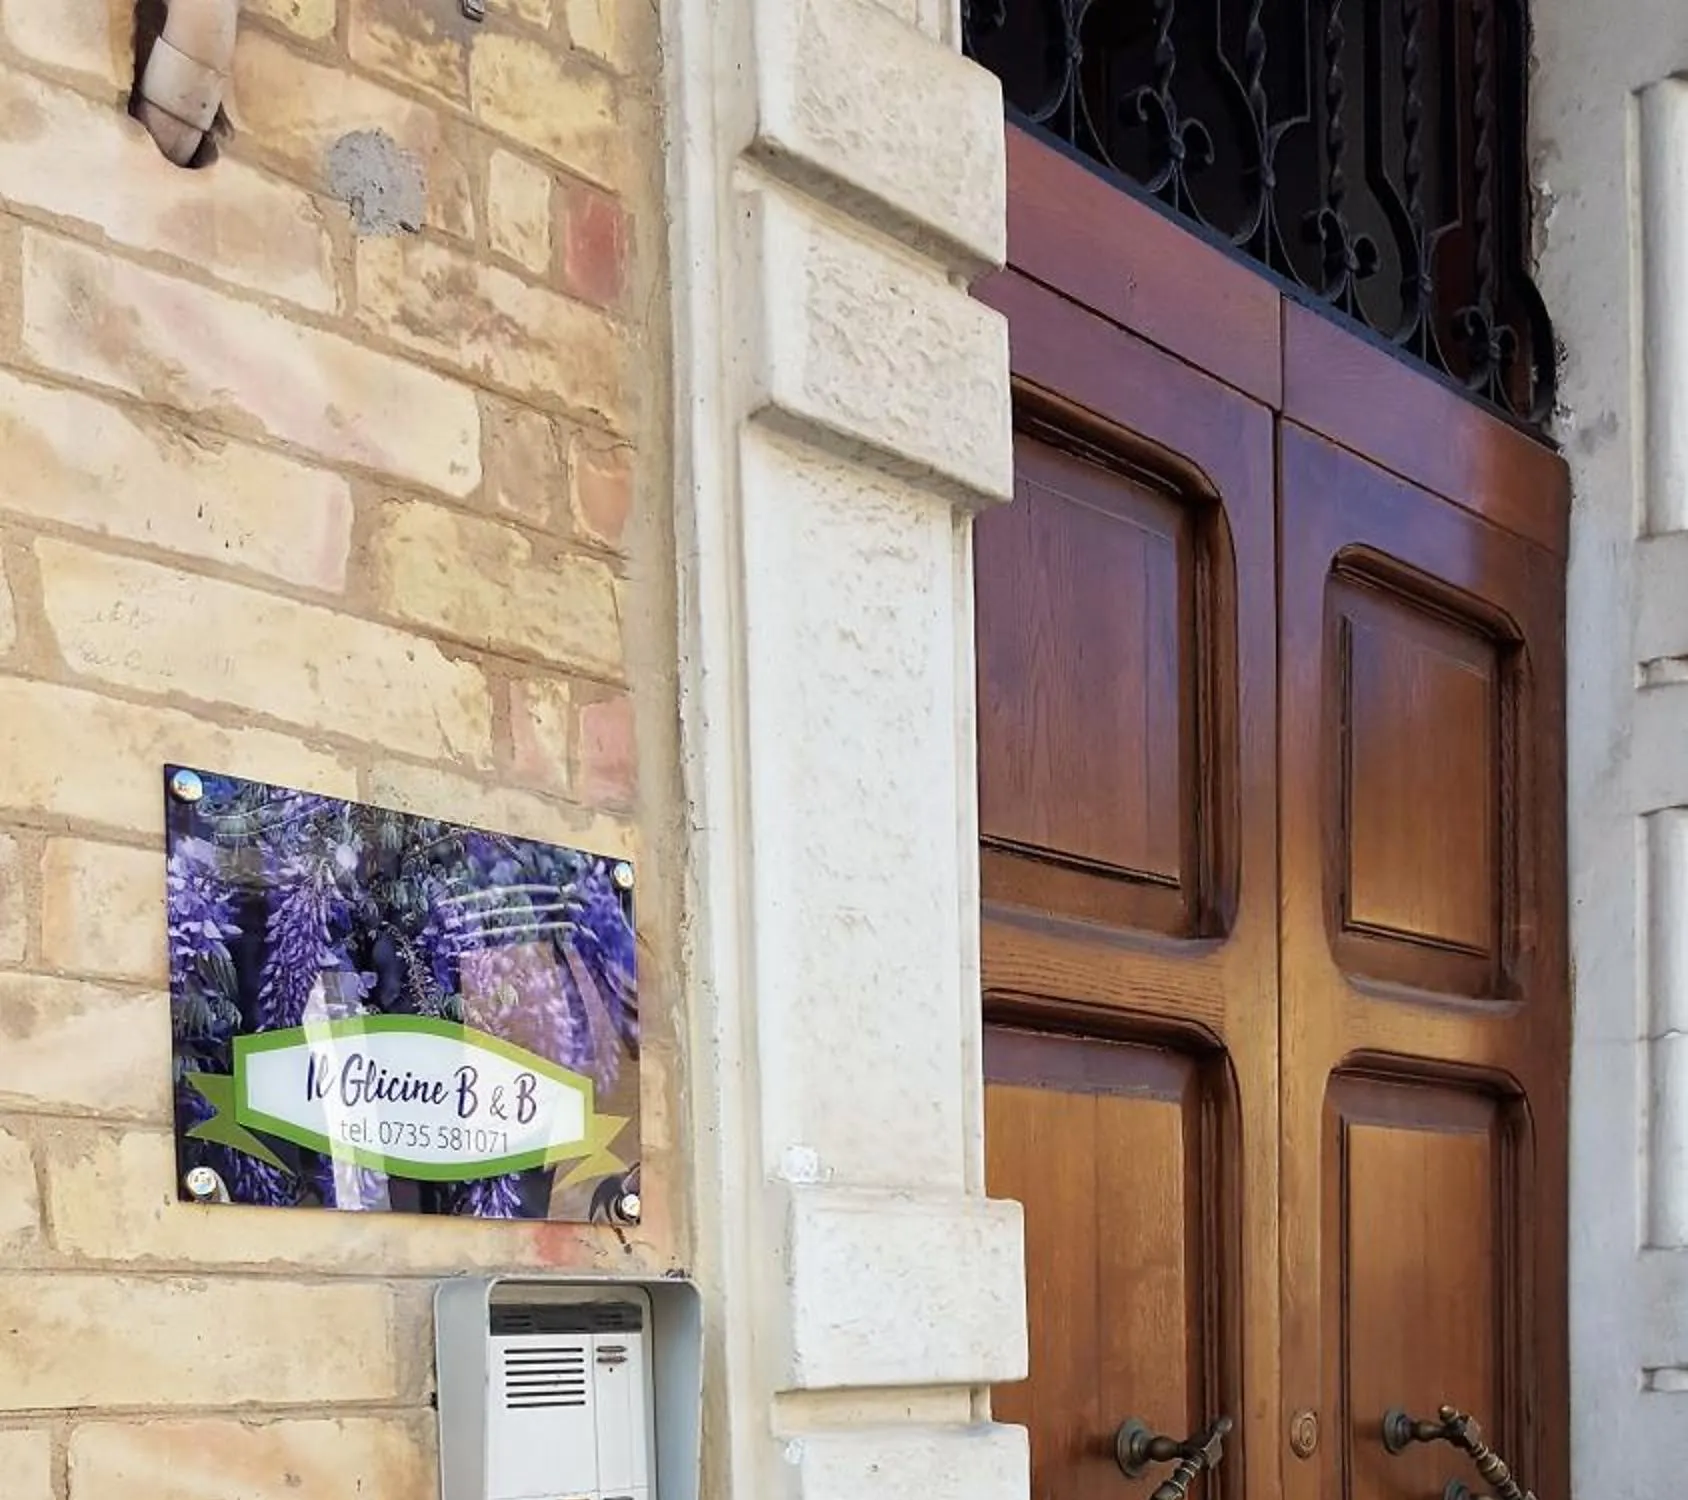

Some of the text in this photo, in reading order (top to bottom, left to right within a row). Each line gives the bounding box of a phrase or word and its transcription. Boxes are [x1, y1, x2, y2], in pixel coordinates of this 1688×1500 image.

[306, 1051, 537, 1124] Il Glicine B & B
[341, 1117, 508, 1153] tel. 0735 581071
